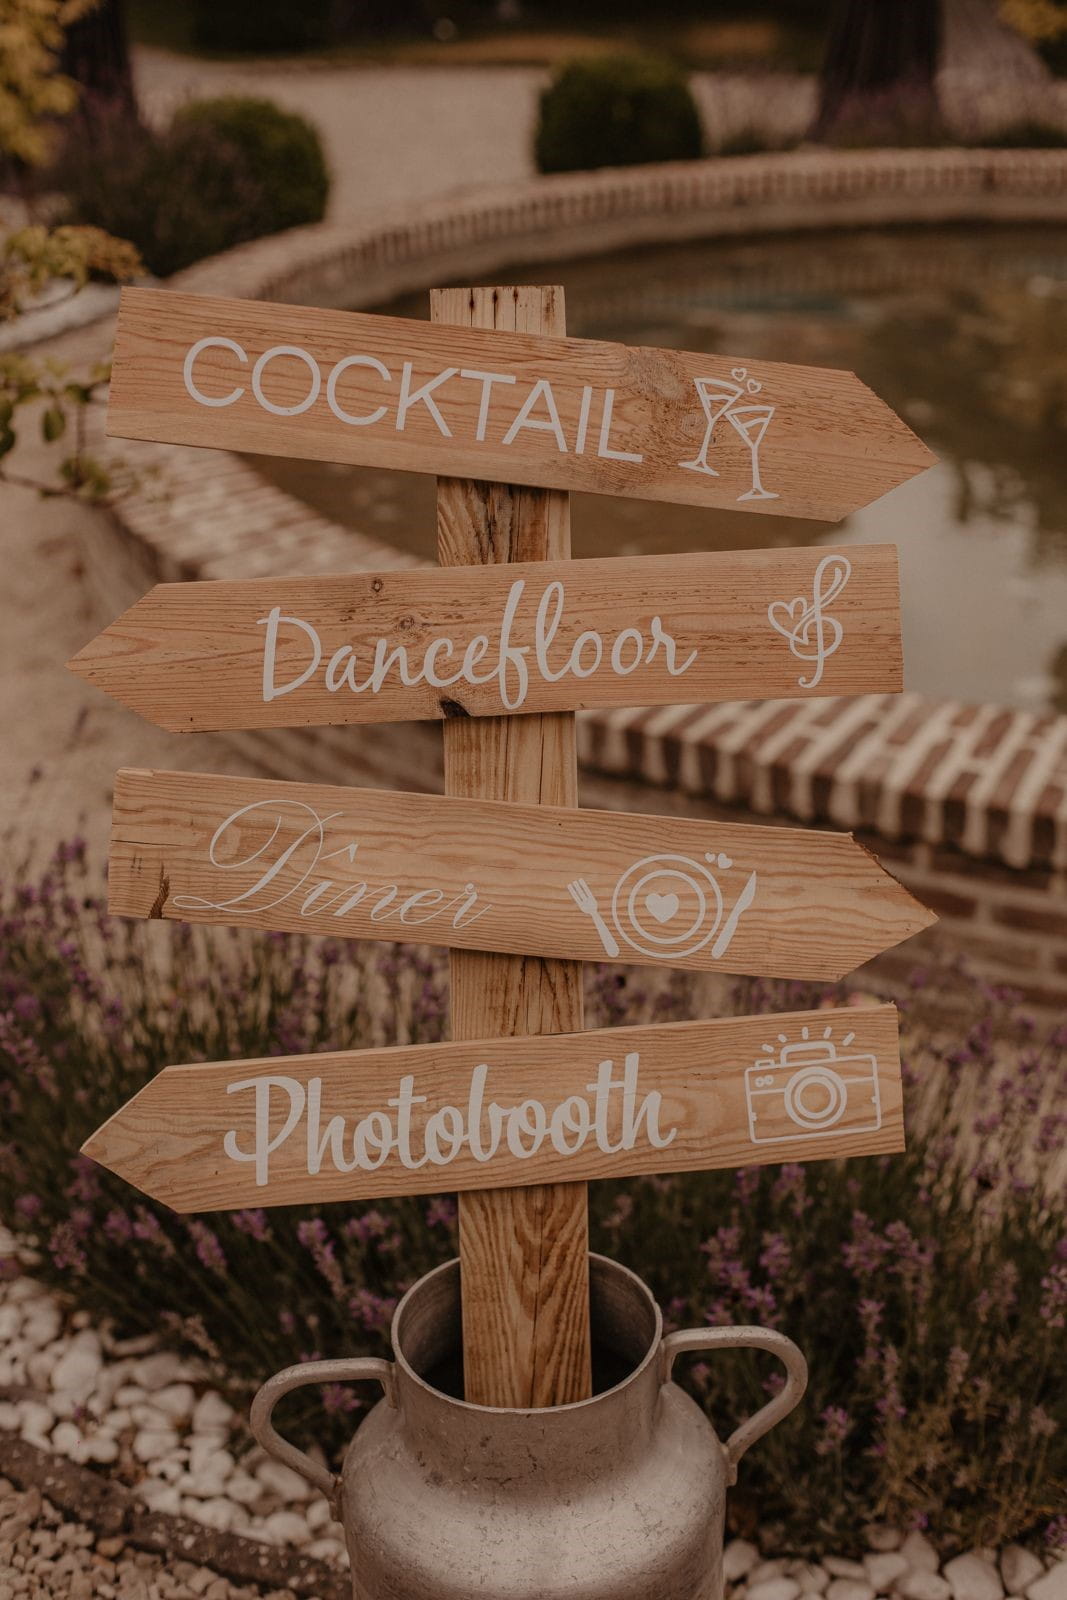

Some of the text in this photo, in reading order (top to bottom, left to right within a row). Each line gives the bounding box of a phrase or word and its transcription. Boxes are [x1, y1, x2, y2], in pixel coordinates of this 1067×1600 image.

[183, 336, 643, 463] COCKTAIL
[256, 579, 697, 710] Dancefloor
[172, 799, 492, 929] Dîner
[223, 1052, 677, 1186] Photobooth
